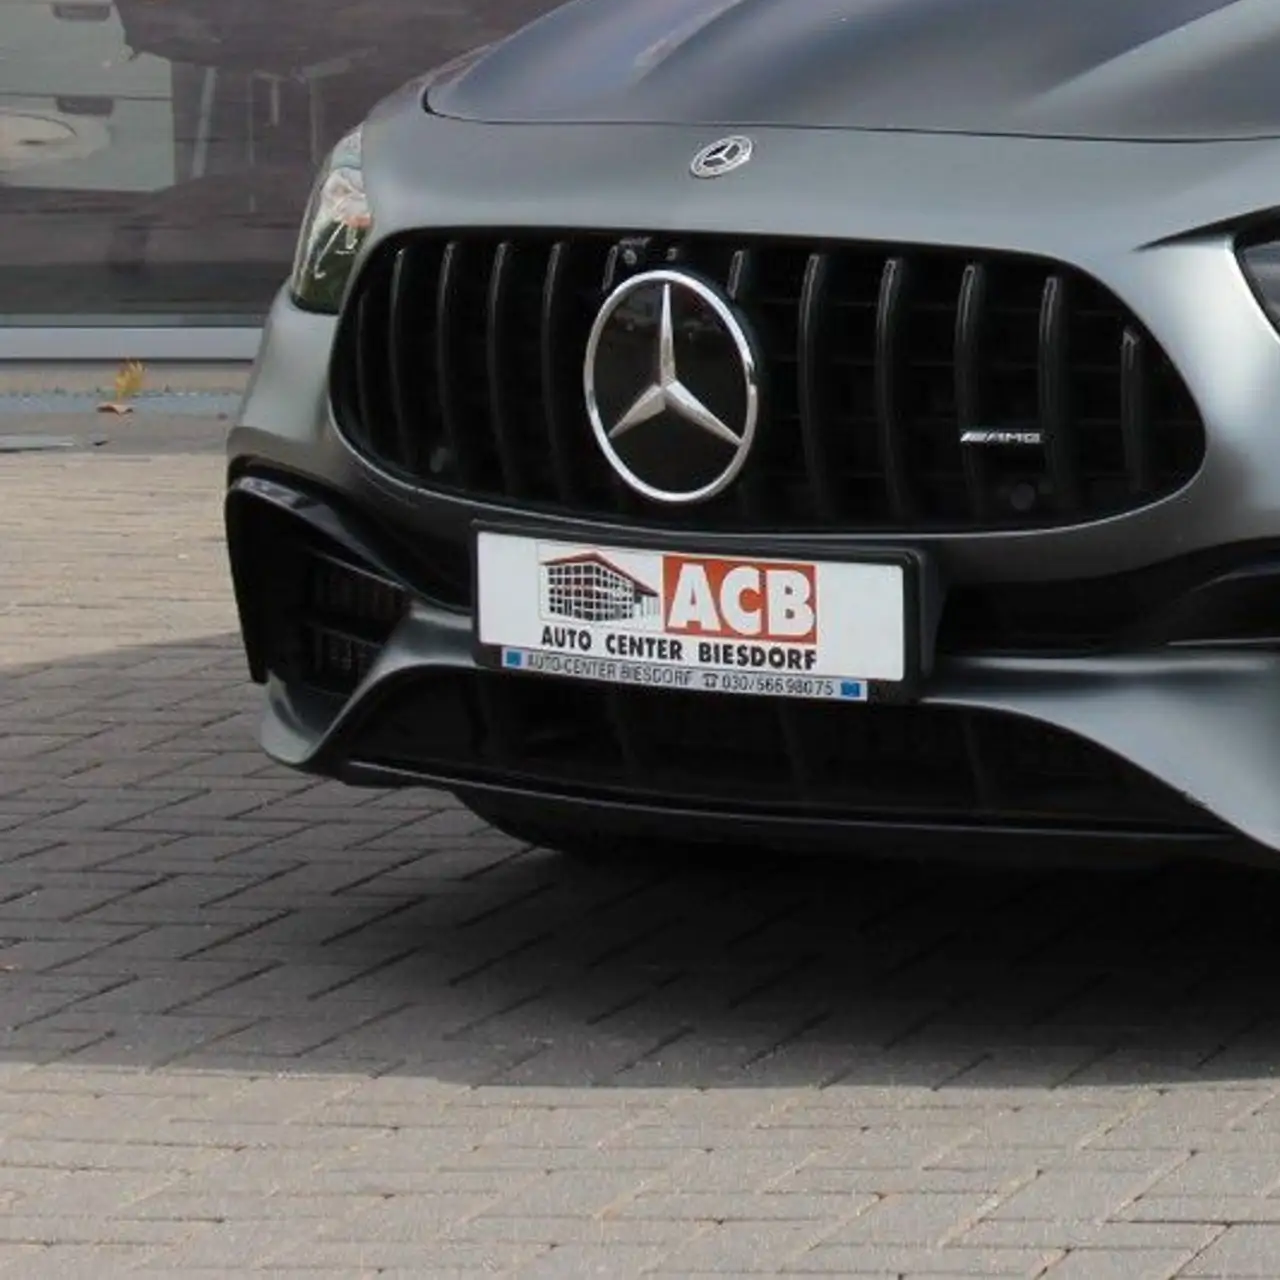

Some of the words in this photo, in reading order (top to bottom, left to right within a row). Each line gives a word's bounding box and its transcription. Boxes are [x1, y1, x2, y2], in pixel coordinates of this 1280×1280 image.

[668, 562, 815, 636] ACB
[542, 626, 593, 652] AUTO
[605, 634, 684, 662] CENTER
[699, 642, 817, 669] BIESDORF
